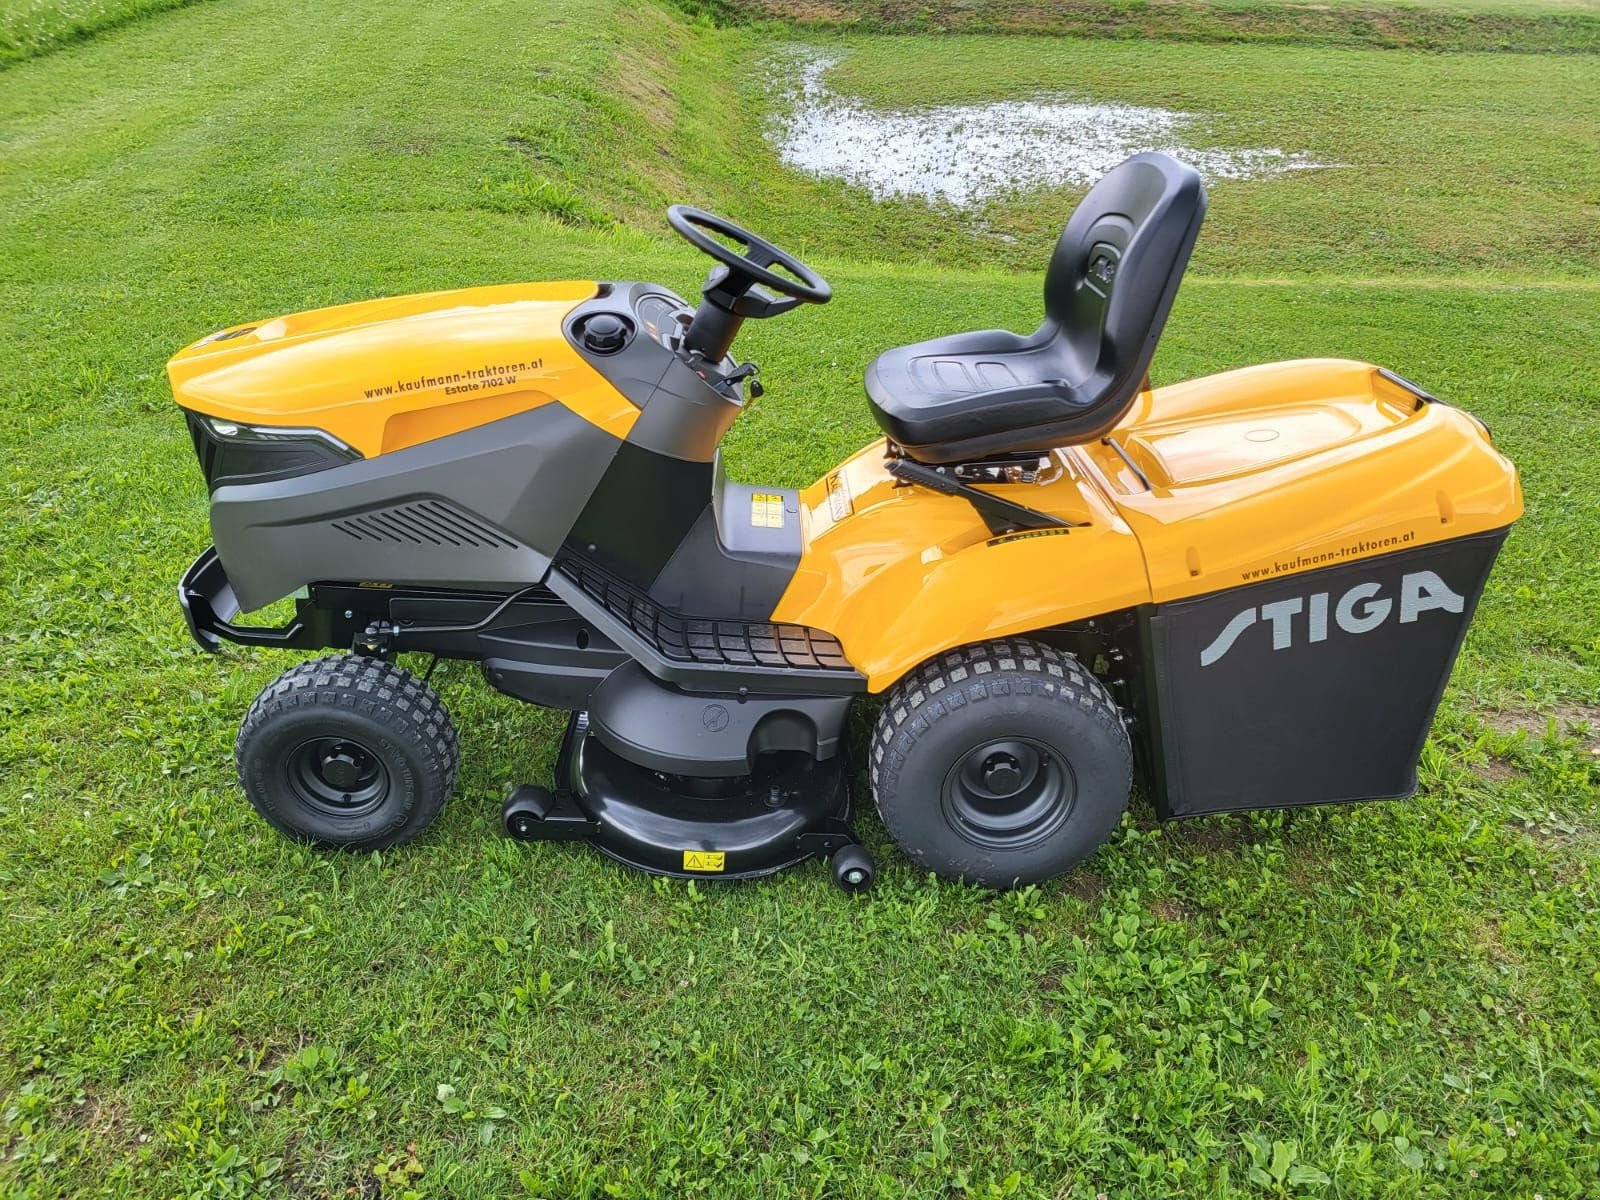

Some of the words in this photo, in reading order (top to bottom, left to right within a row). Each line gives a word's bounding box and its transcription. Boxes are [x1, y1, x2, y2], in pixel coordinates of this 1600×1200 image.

[364, 358, 543, 398] www.kaufmann-traktoren.at
[445, 383, 479, 395] Estate
[480, 378, 504, 390] 7102
[505, 376, 516, 385] W
[1241, 530, 1416, 581] www.kaufmann-traktoren.at
[1200, 570, 1465, 667] STIGA
